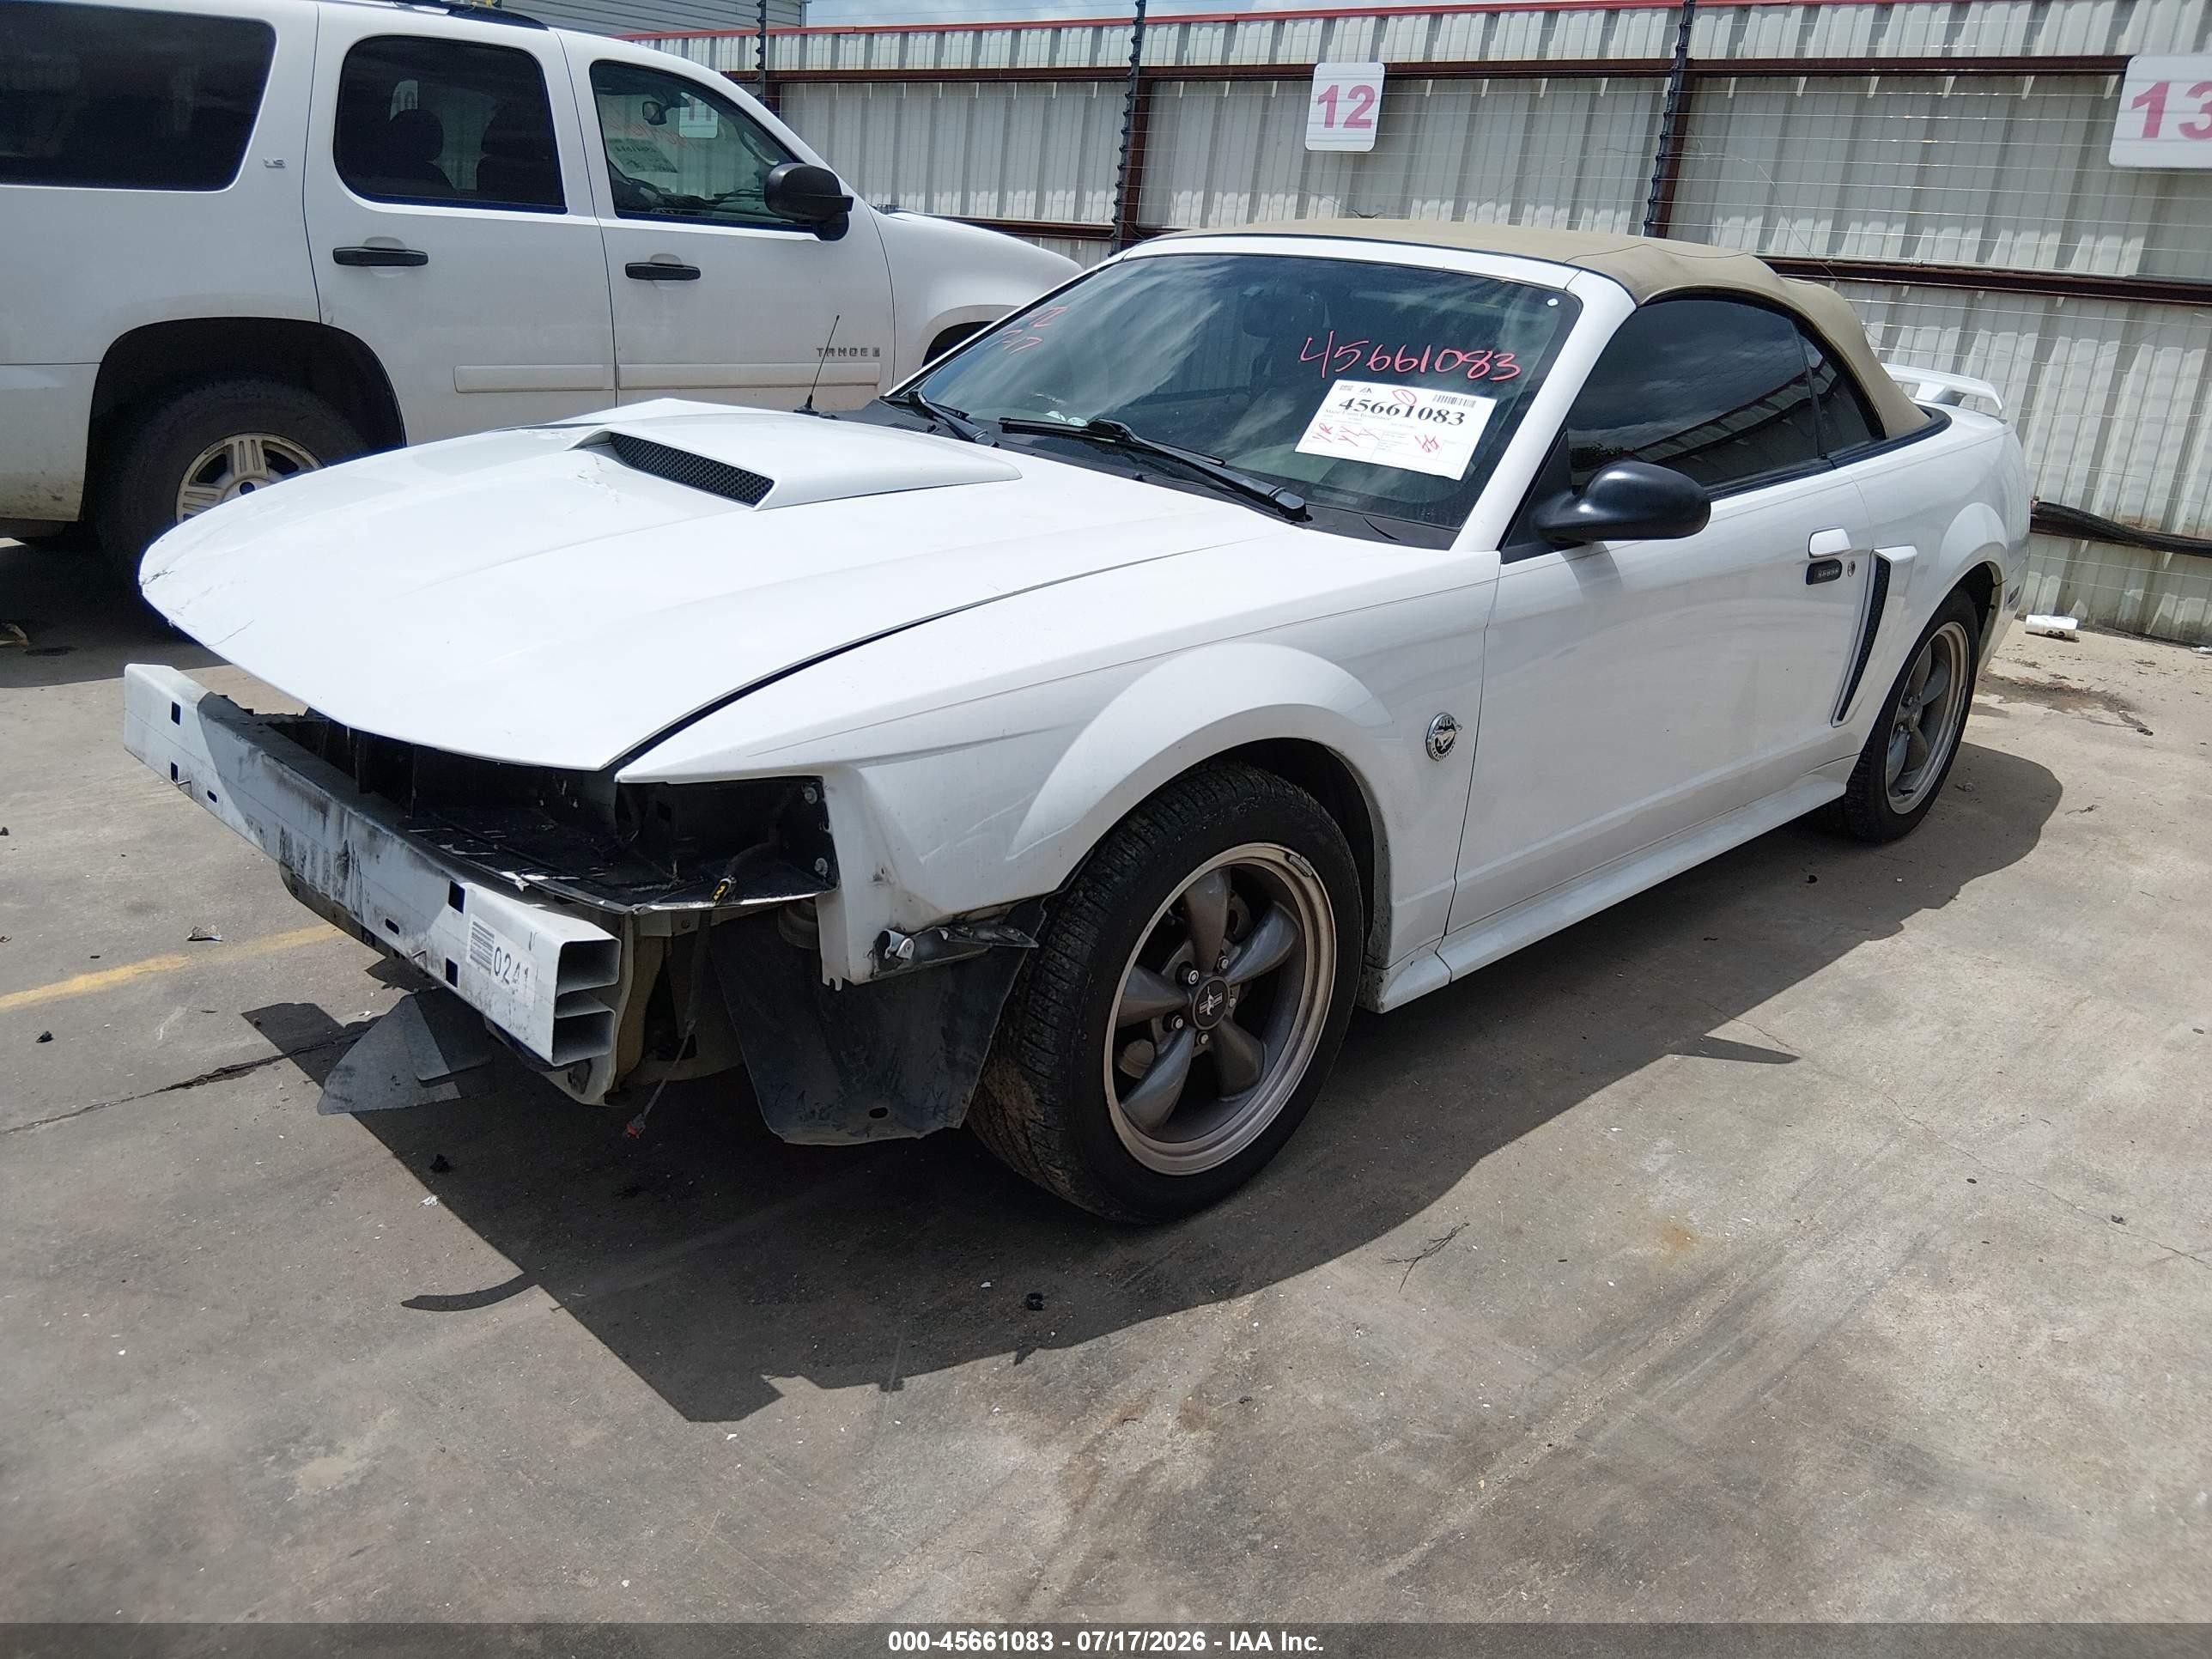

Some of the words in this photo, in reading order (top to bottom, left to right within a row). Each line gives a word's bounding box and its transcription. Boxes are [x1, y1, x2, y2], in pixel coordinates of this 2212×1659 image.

[1317, 84, 1376, 129] 12
[2130, 81, 2212, 139] 13
[817, 347, 868, 357] TAHOE
[1298, 330, 1522, 381] 45661083
[1339, 398, 1465, 426] 45661083
